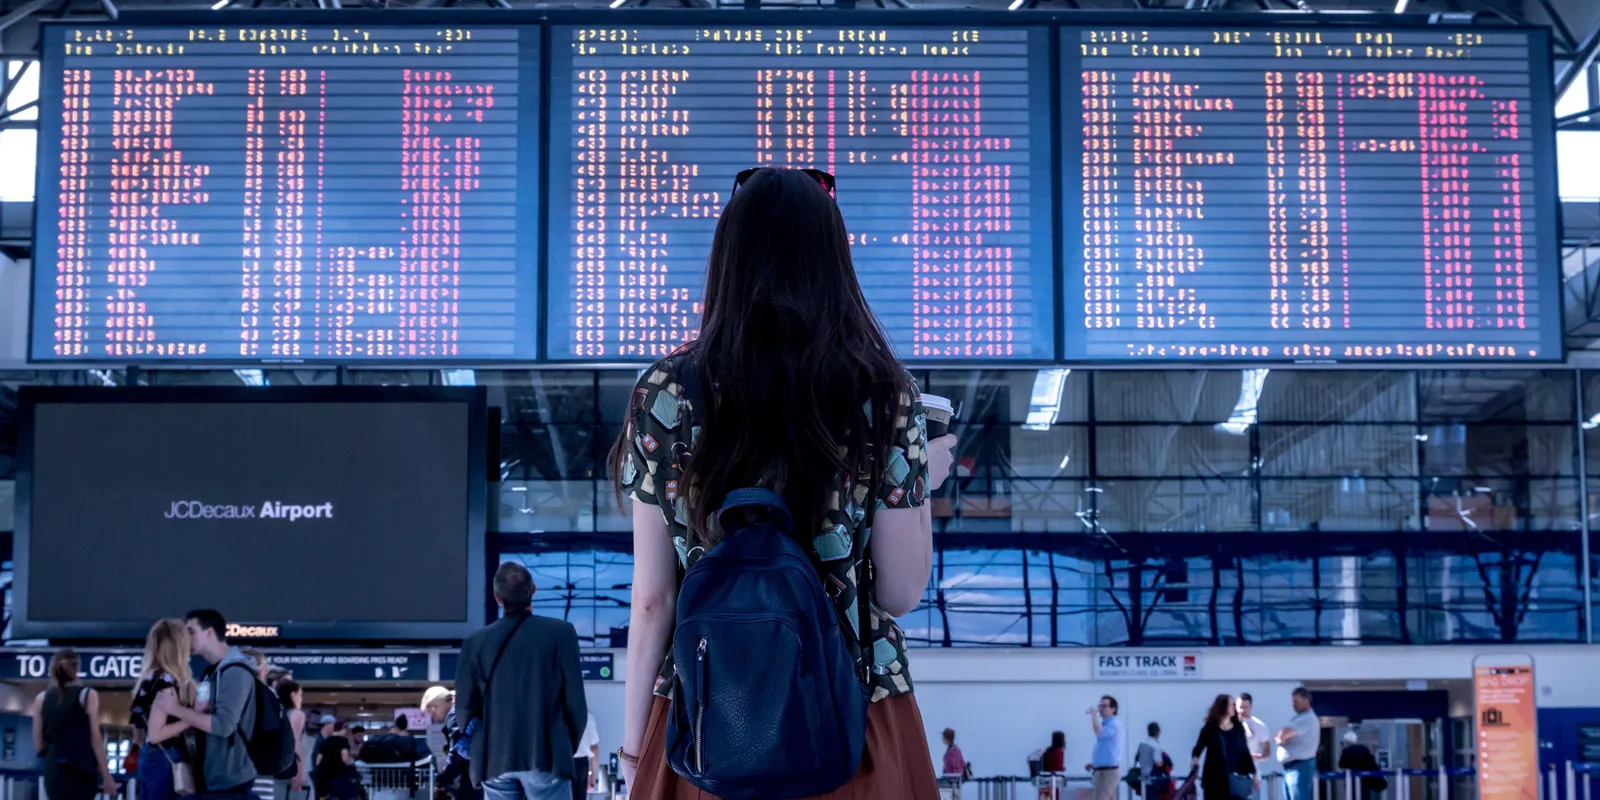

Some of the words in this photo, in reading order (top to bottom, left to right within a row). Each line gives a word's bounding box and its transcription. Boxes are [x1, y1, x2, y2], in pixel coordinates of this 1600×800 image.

[164, 500, 255, 519] JCDecaux
[259, 501, 333, 521] Airport
[16, 655, 46, 677] TO
[1099, 655, 1130, 667] FAST
[1135, 655, 1177, 667] TRACK
